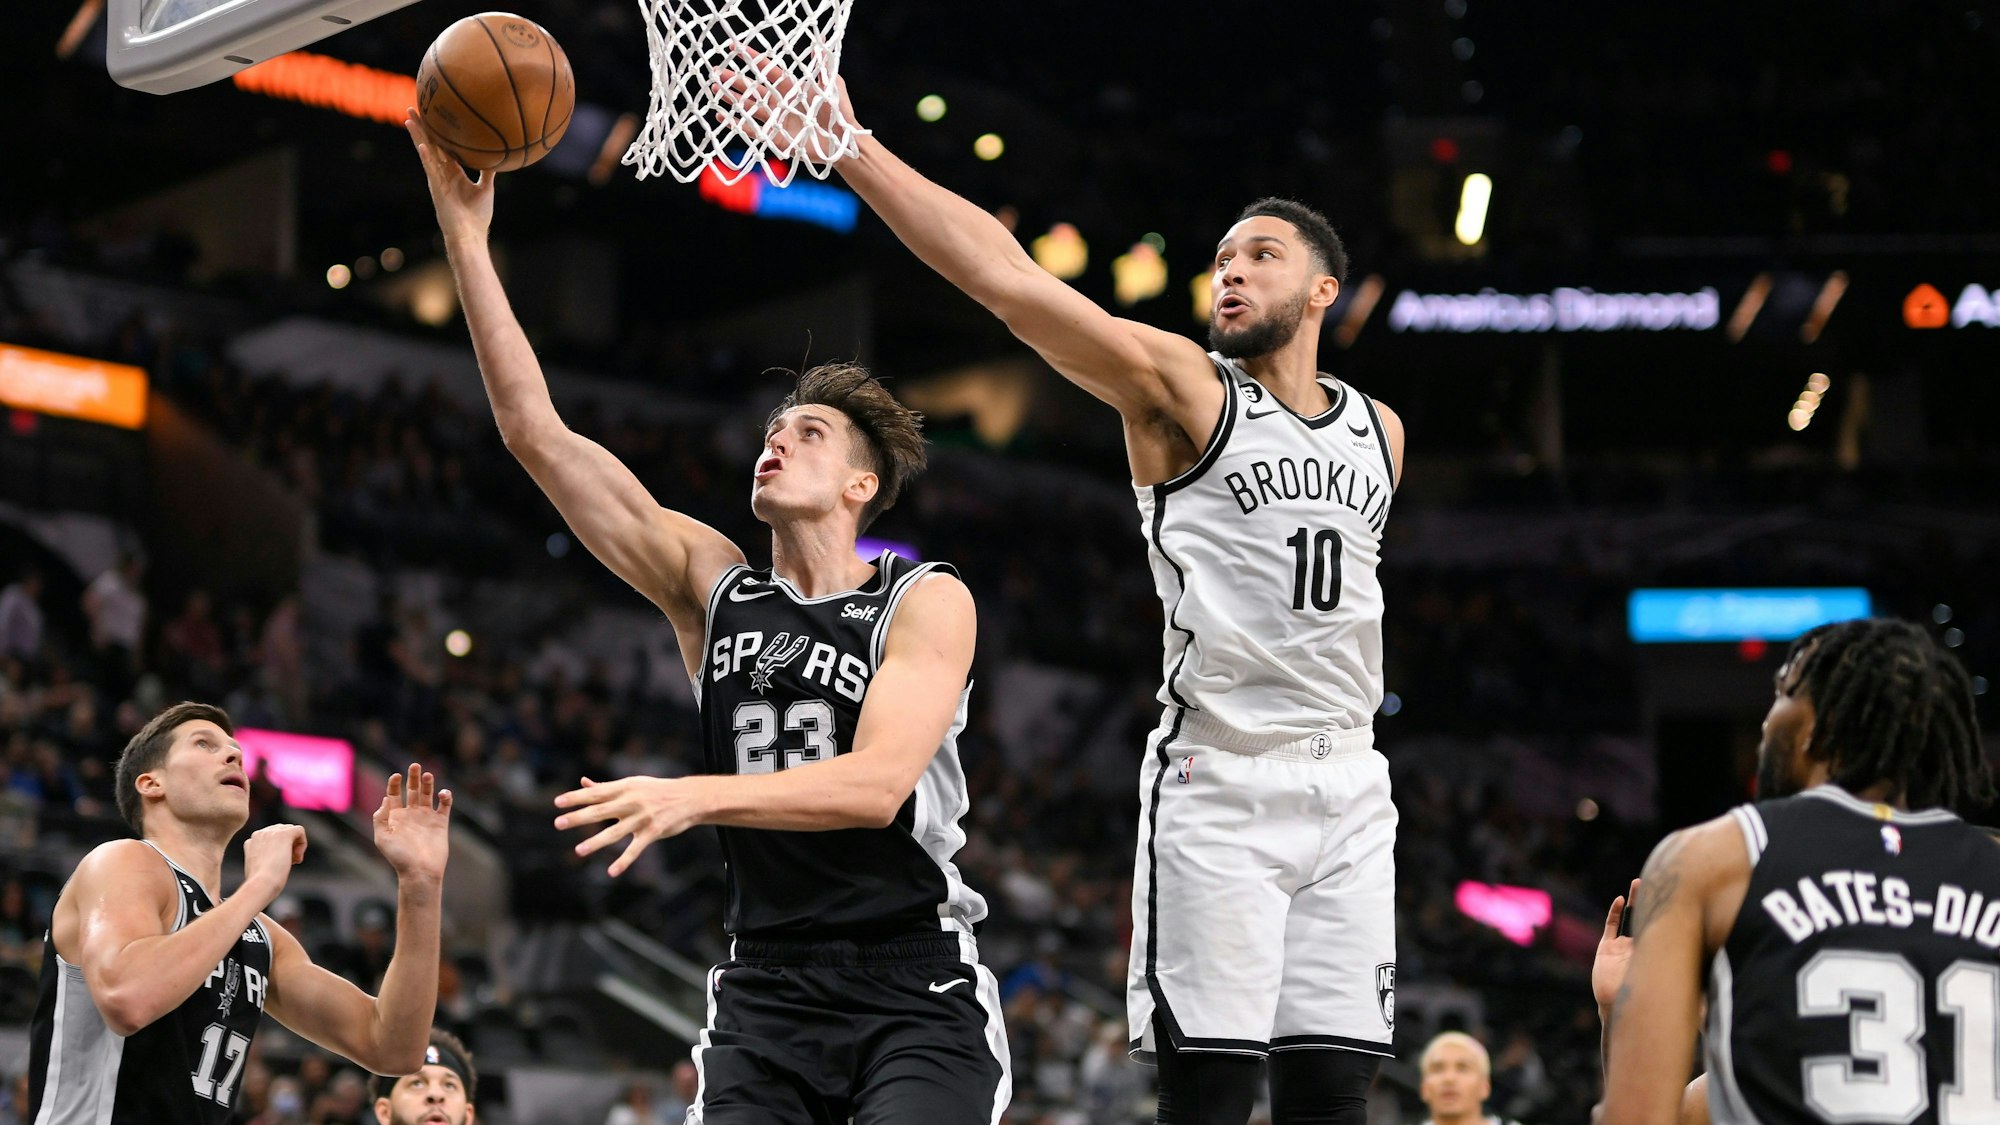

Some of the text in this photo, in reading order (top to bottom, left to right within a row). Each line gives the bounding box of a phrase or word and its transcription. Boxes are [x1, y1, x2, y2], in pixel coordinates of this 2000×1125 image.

[1224, 457, 1390, 533] BROOKLYN
[1286, 527, 1343, 612] 10
[732, 698, 838, 775] 23
[191, 1022, 251, 1109] 17
[1796, 948, 2000, 1125] 31
